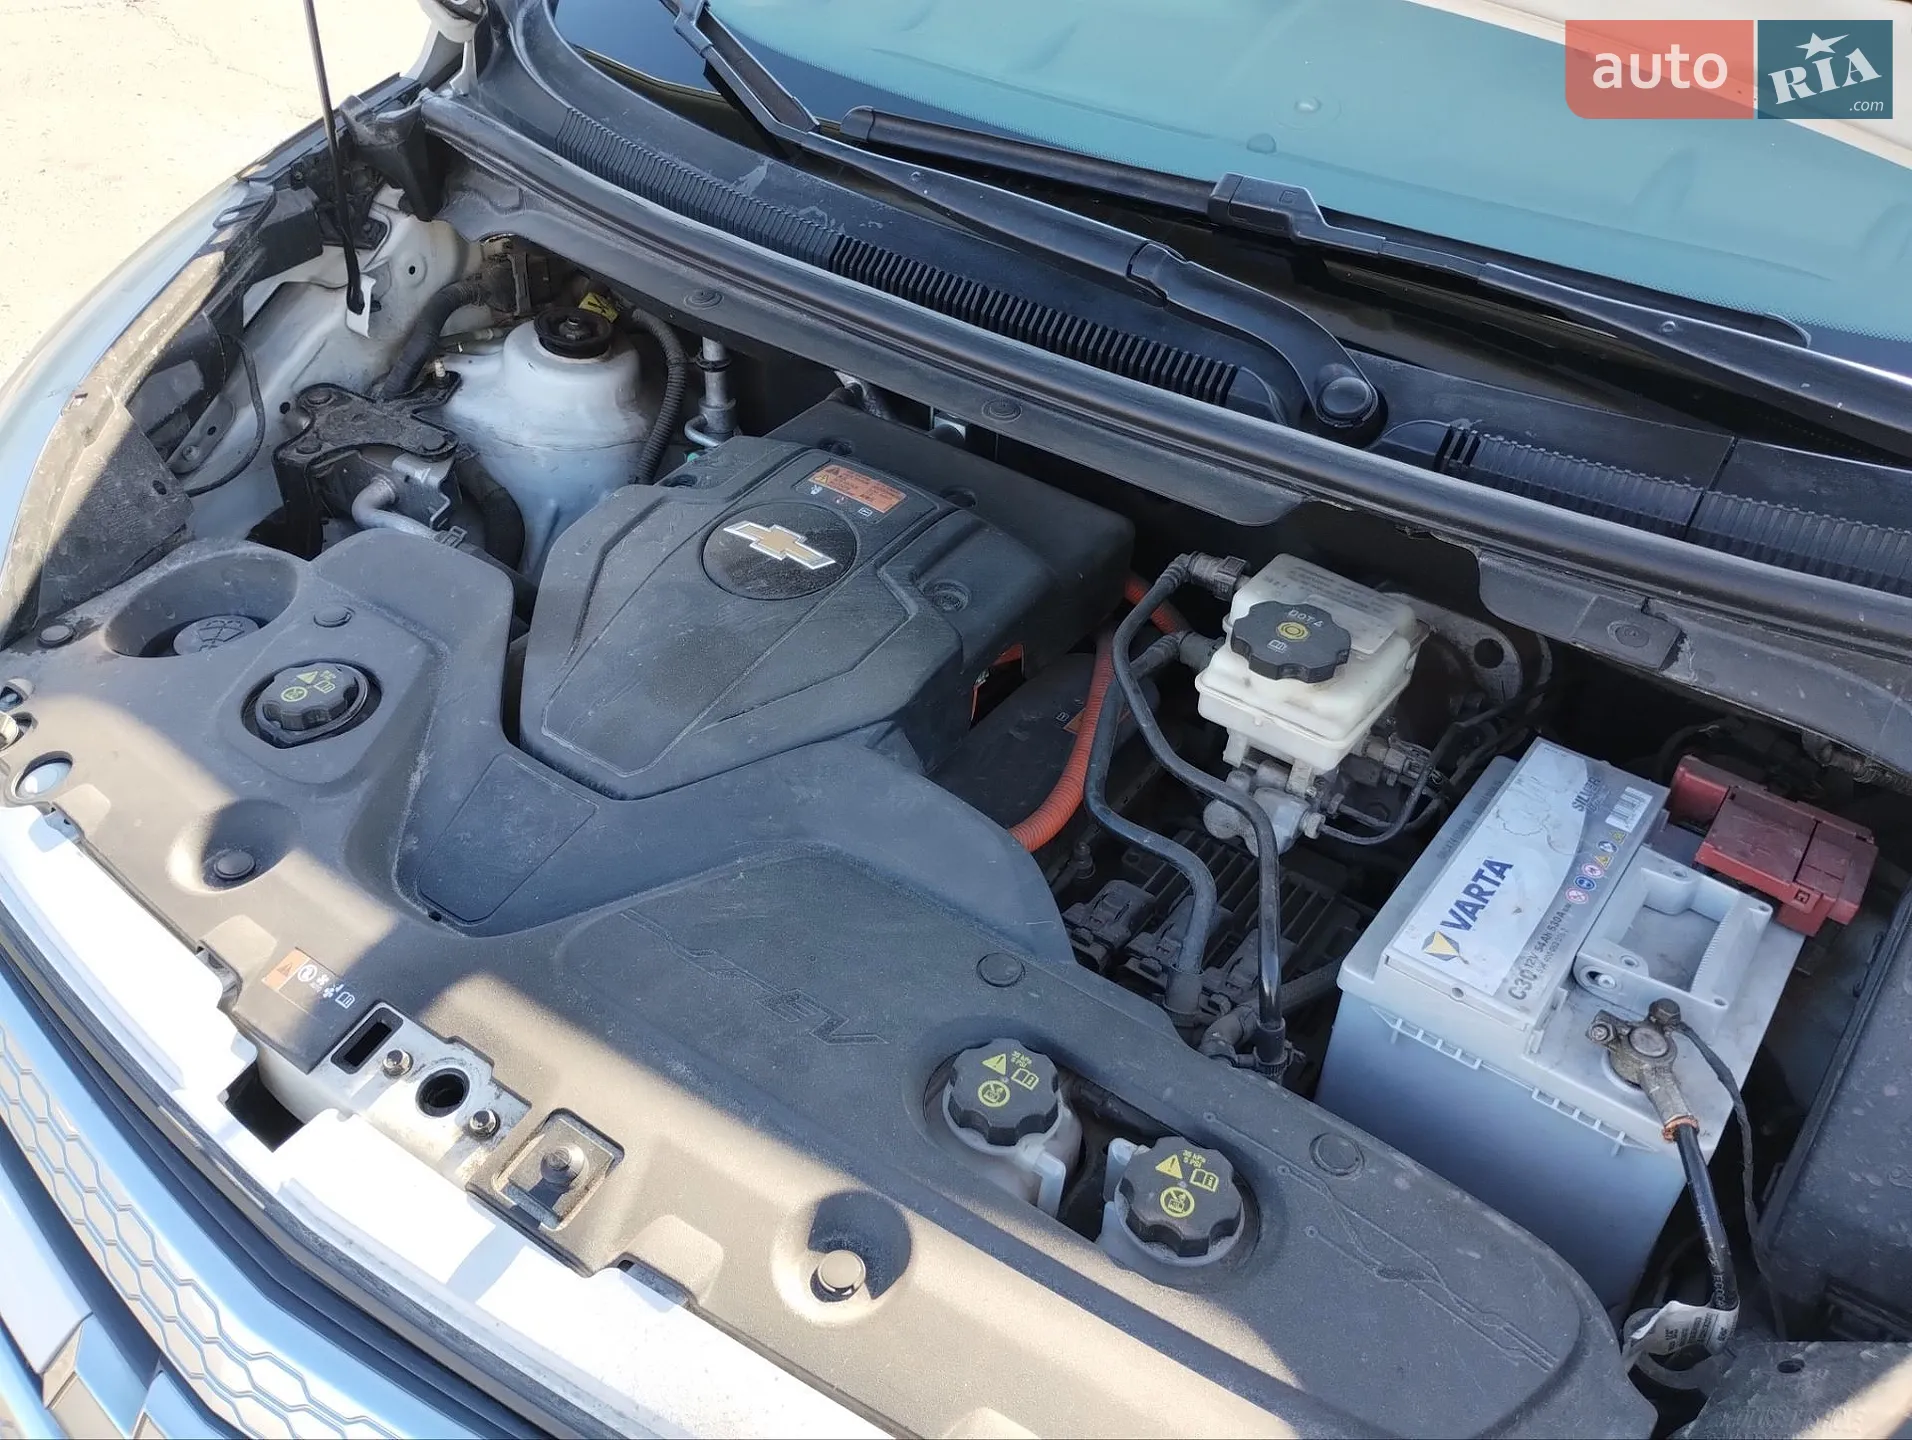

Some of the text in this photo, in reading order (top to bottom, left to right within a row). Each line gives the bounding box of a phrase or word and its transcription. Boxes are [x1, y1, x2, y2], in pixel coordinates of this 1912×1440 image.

[1288, 609, 1315, 622] DOT
[1571, 776, 1601, 812] SILVER
[1440, 858, 1514, 932] VARTA
[1524, 952, 1538, 968] 12V
[1508, 967, 1537, 1000] C30
